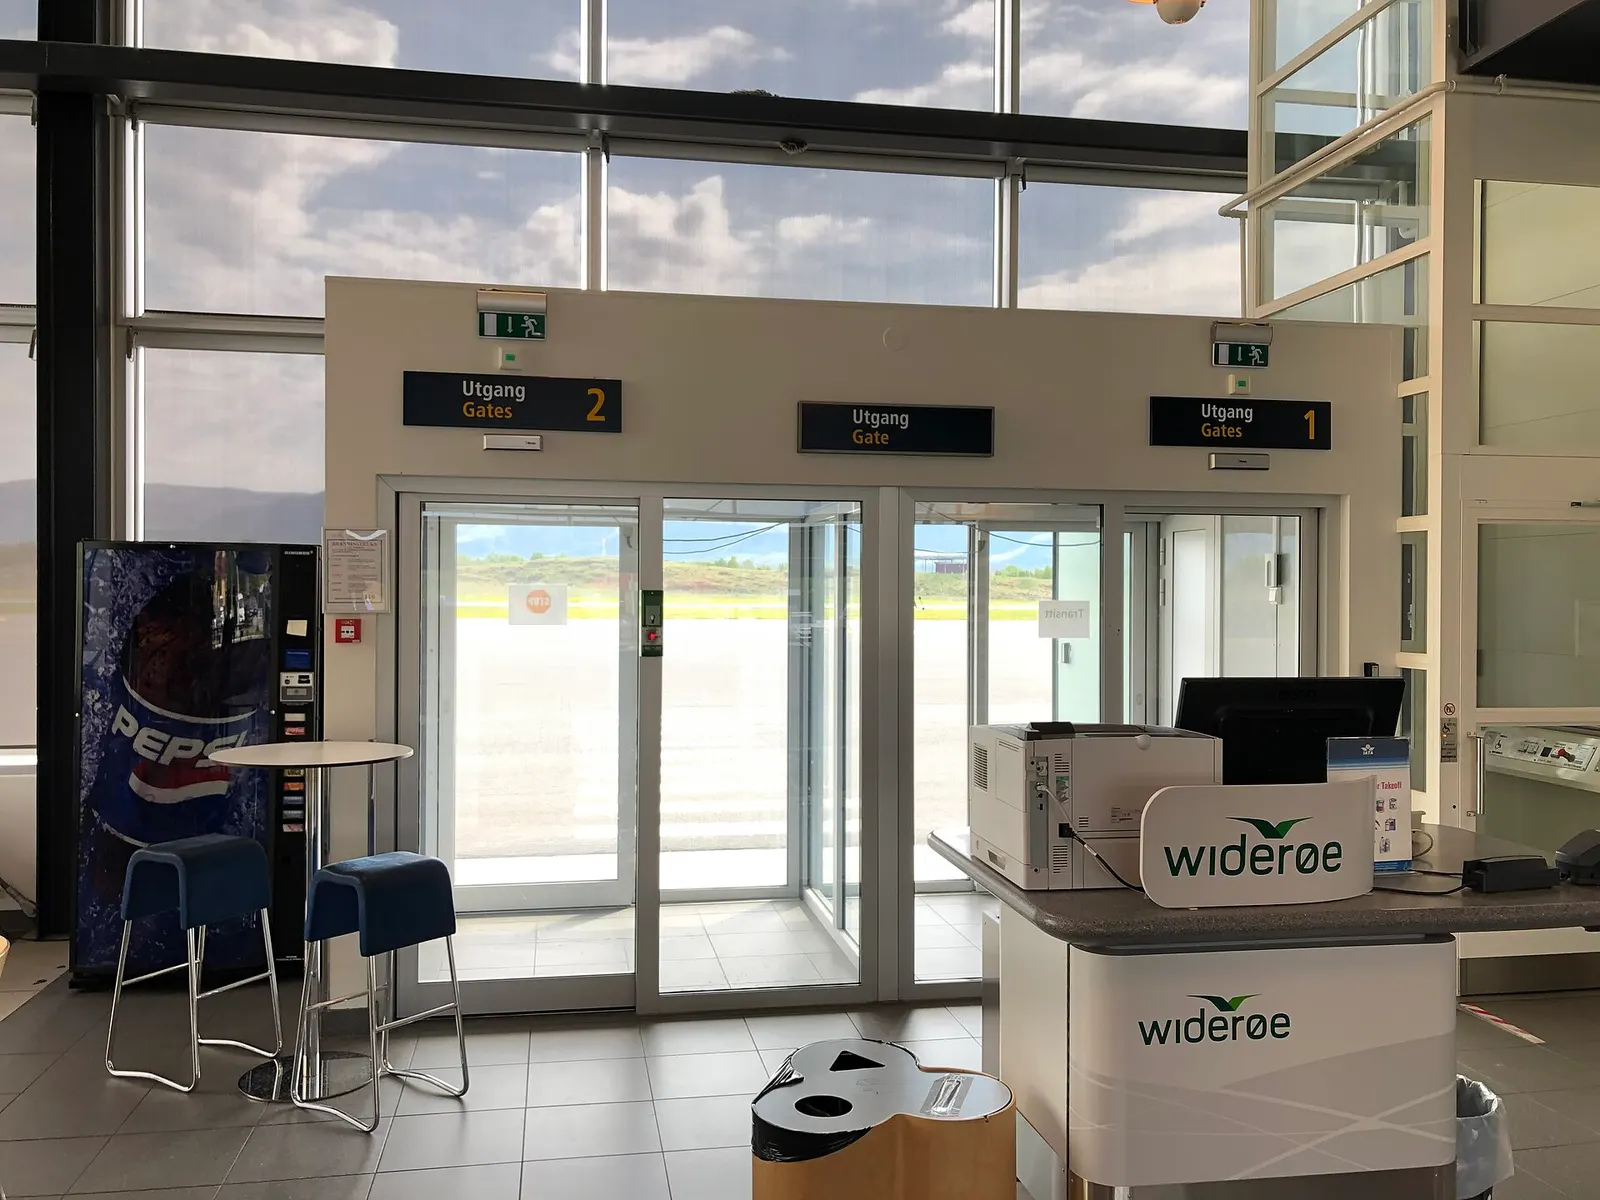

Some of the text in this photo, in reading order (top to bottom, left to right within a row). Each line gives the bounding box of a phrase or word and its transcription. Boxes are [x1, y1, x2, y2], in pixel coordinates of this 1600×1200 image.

[462, 380, 526, 402] Utgang
[462, 401, 513, 419] Gates
[586, 387, 606, 422] 2
[1201, 403, 1253, 423] Utgang
[852, 408, 909, 429] Utgang
[1303, 409, 1315, 440] 1
[852, 429, 889, 445] Gate
[1201, 423, 1243, 438] Gates
[1163, 833, 1343, 877] widerøe
[1137, 1007, 1291, 1046] widerøe
